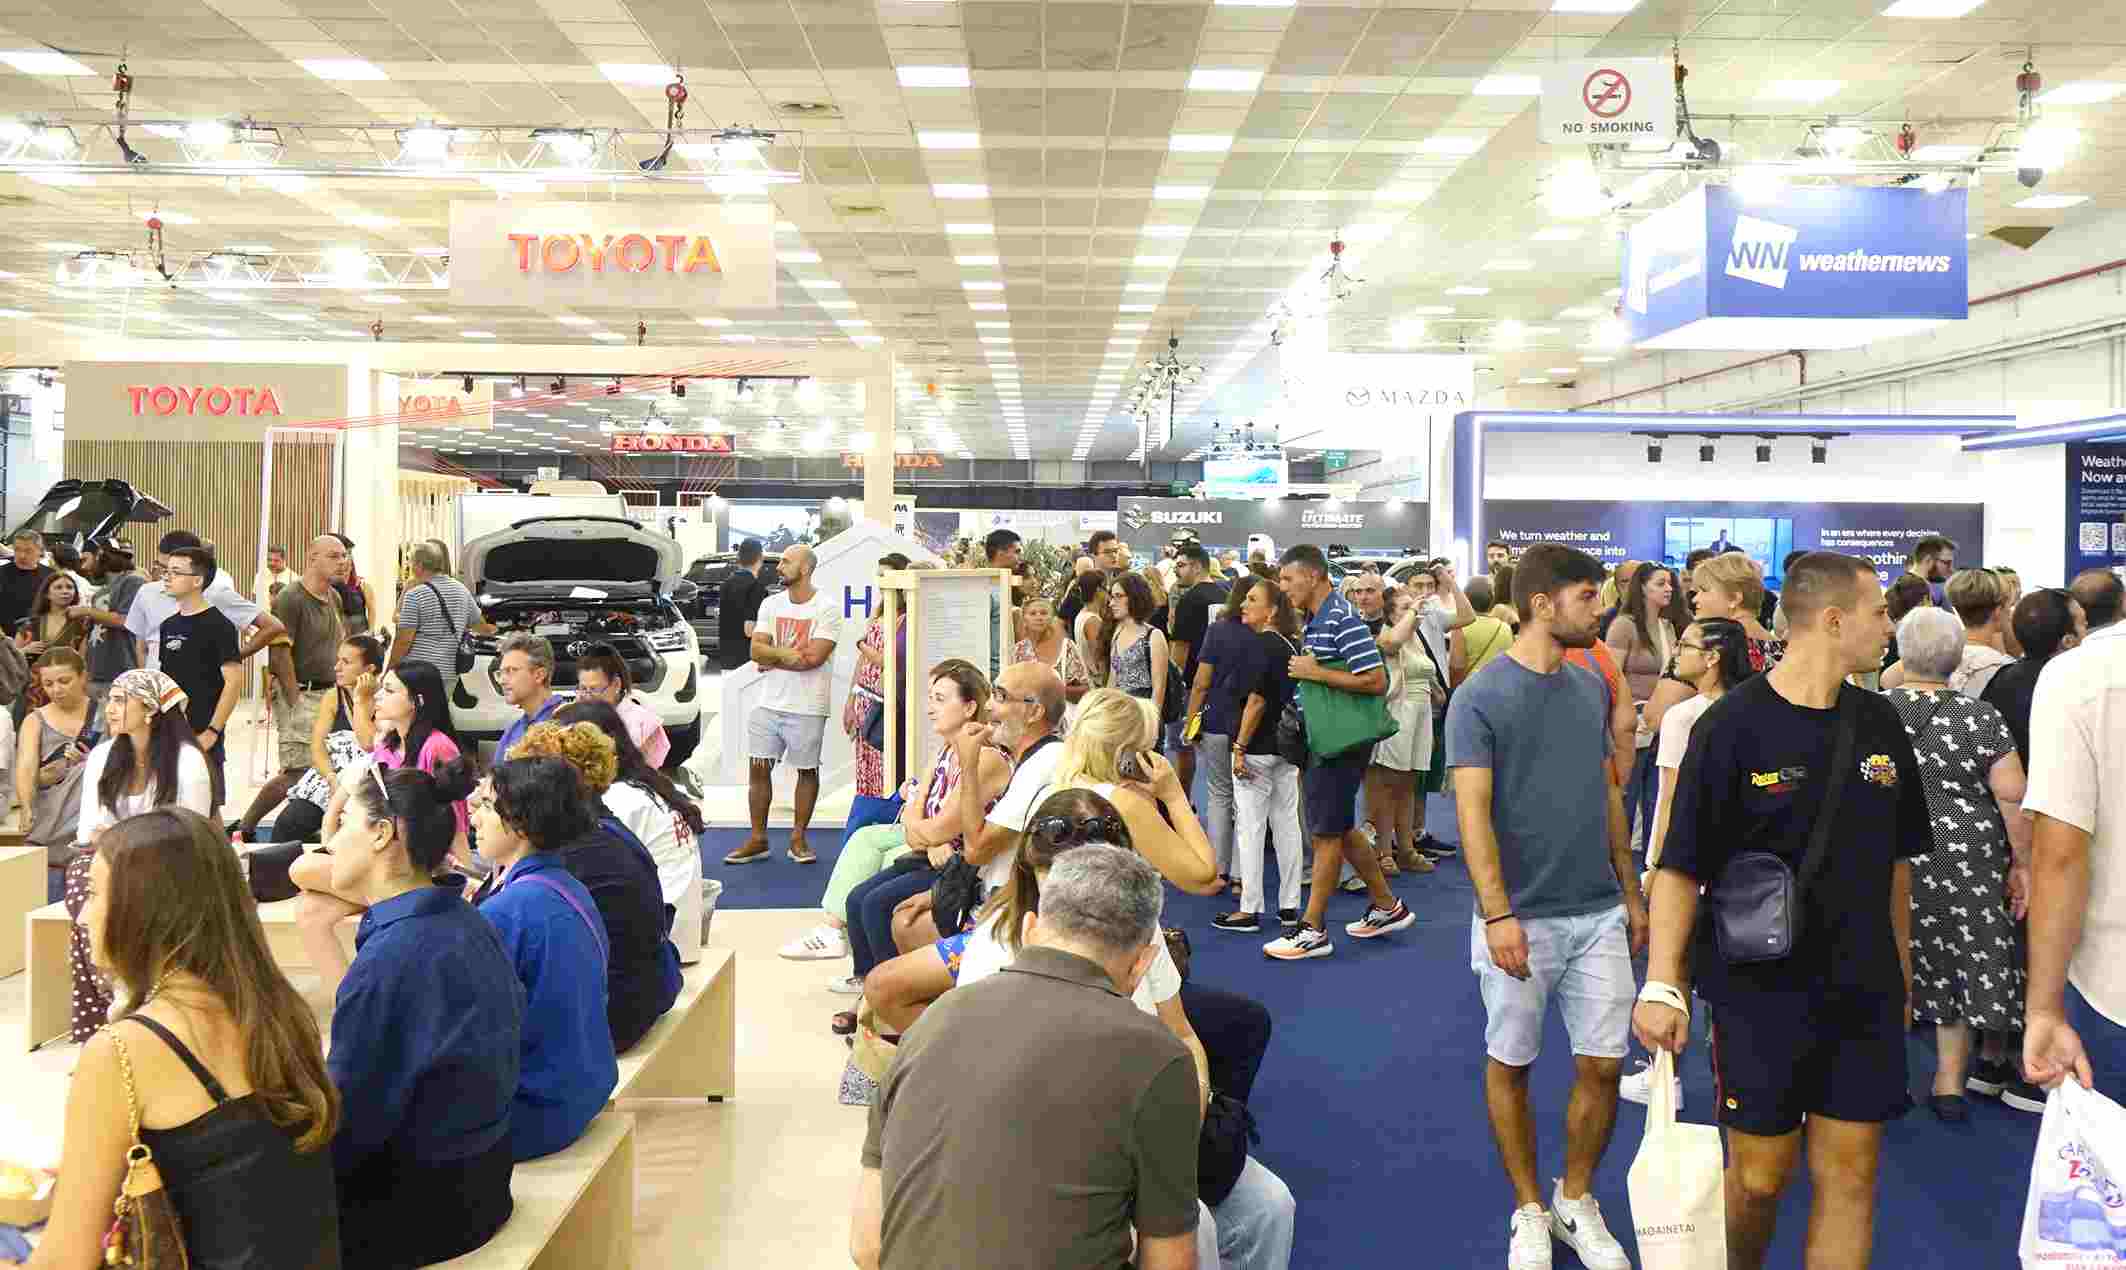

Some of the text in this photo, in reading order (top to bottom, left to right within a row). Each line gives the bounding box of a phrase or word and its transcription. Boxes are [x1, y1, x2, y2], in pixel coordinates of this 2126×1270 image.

[1562, 121, 1655, 134] NO SMOKING
[507, 233, 713, 273] TOYOTA
[1799, 249, 1952, 273] weathernews
[128, 385, 282, 416] TOYOTA
[1380, 390, 1465, 405] MAZDA
[399, 396, 461, 416] YOTA
[614, 434, 730, 452] HONDA
[2081, 455, 2126, 468] Weath
[2081, 471, 2113, 483] Now
[1150, 511, 1223, 524] SUZUKI
[1500, 530, 1611, 541] We turn weather and
[1821, 528, 1829, 537] In
[1856, 529, 1881, 537] where
[1883, 530, 1904, 539] every
[1837, 539, 1895, 548] consequences
[1605, 545, 1626, 556] into
